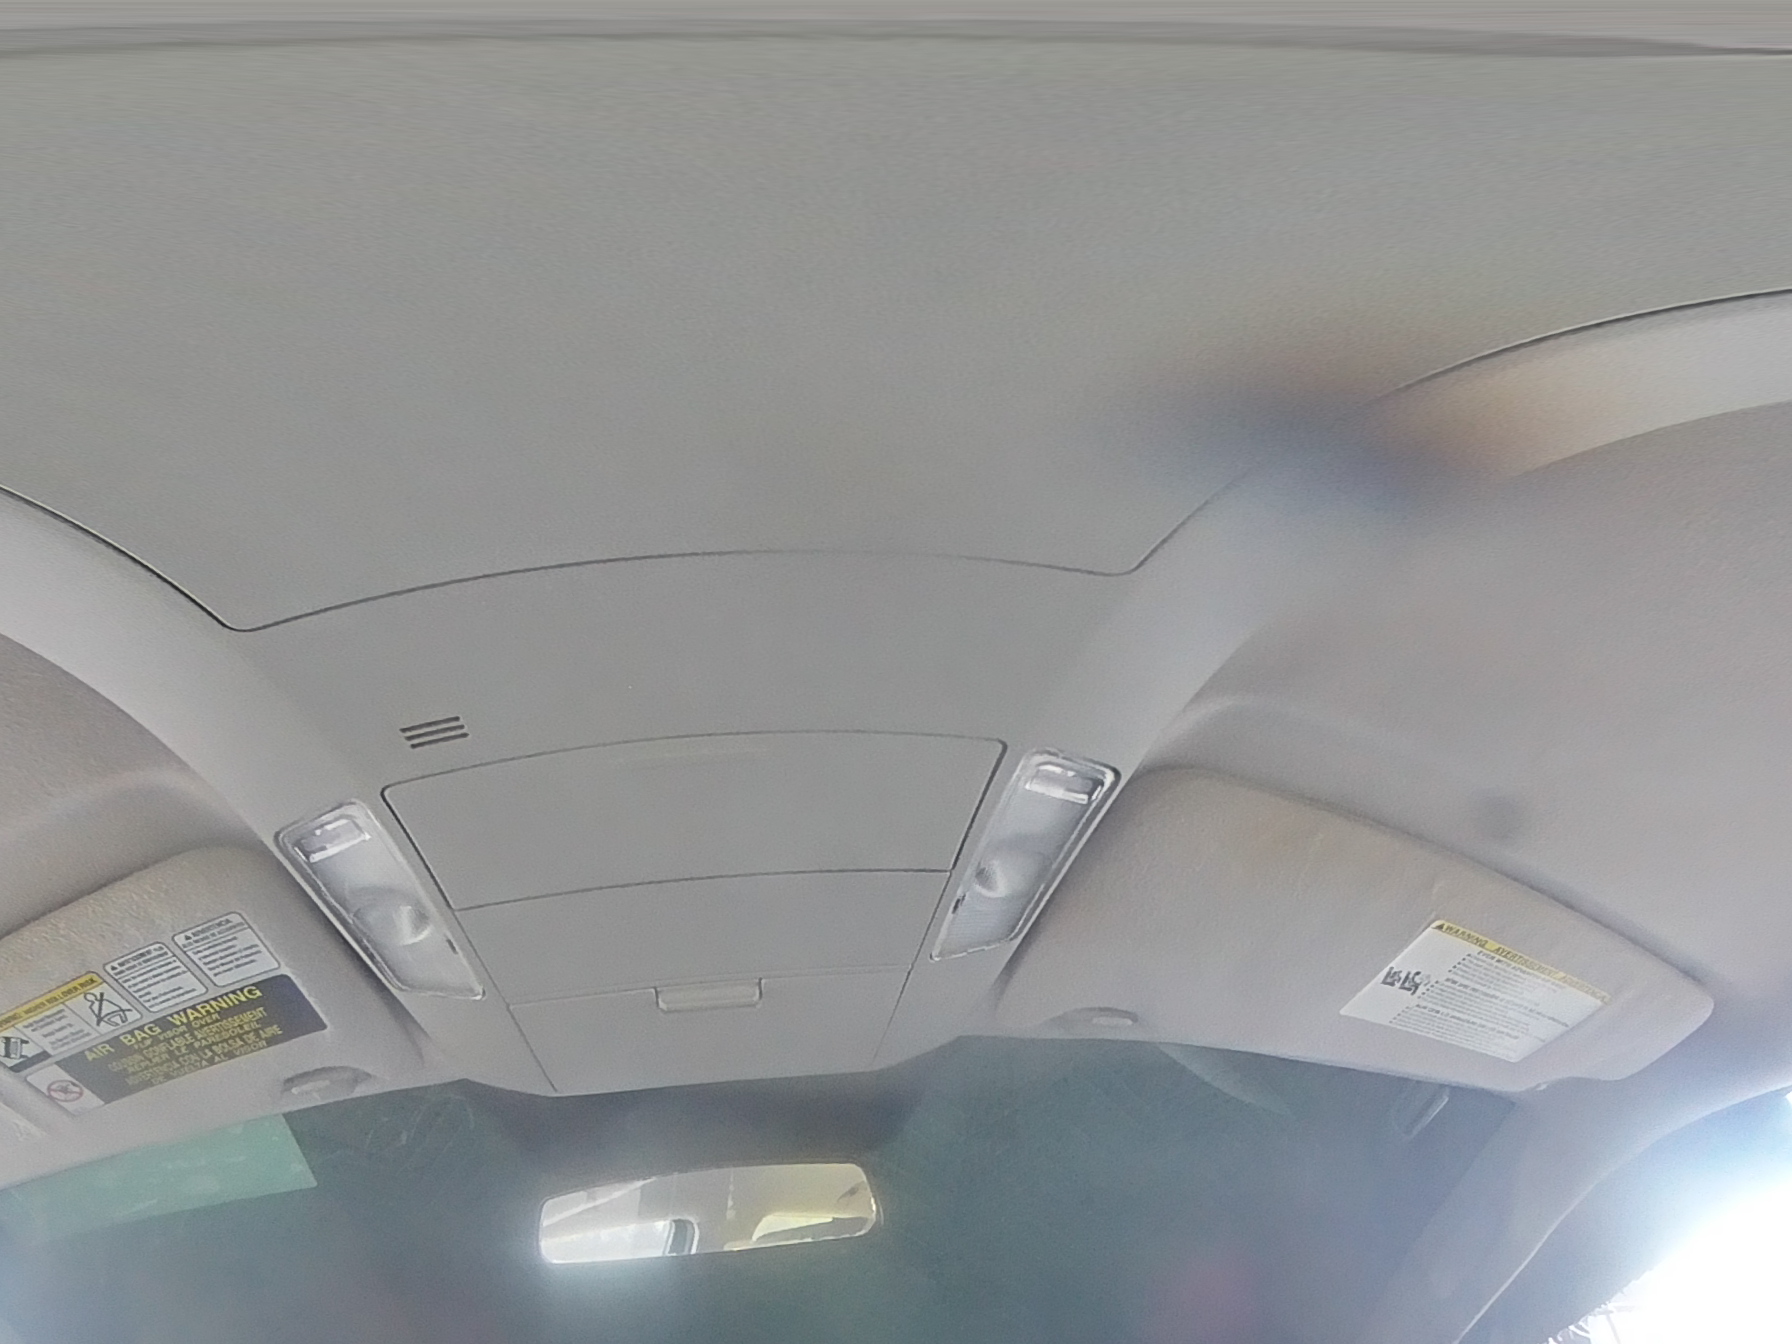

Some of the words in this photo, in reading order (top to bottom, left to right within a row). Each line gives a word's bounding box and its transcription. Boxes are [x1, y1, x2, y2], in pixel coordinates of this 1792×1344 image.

[1446, 924, 1489, 947] WARNING
[84, 1043, 115, 1061] AIR
[119, 1023, 162, 1046] BAG
[167, 985, 263, 1025] WARNING
[157, 1025, 187, 1040] VISOR
[191, 1013, 220, 1028] OVER
[194, 1007, 267, 1039] AVERTISSEMENT
[258, 1024, 283, 1039] AIRE
[174, 1045, 189, 1056] LE
[234, 1040, 267, 1055] VISOR
